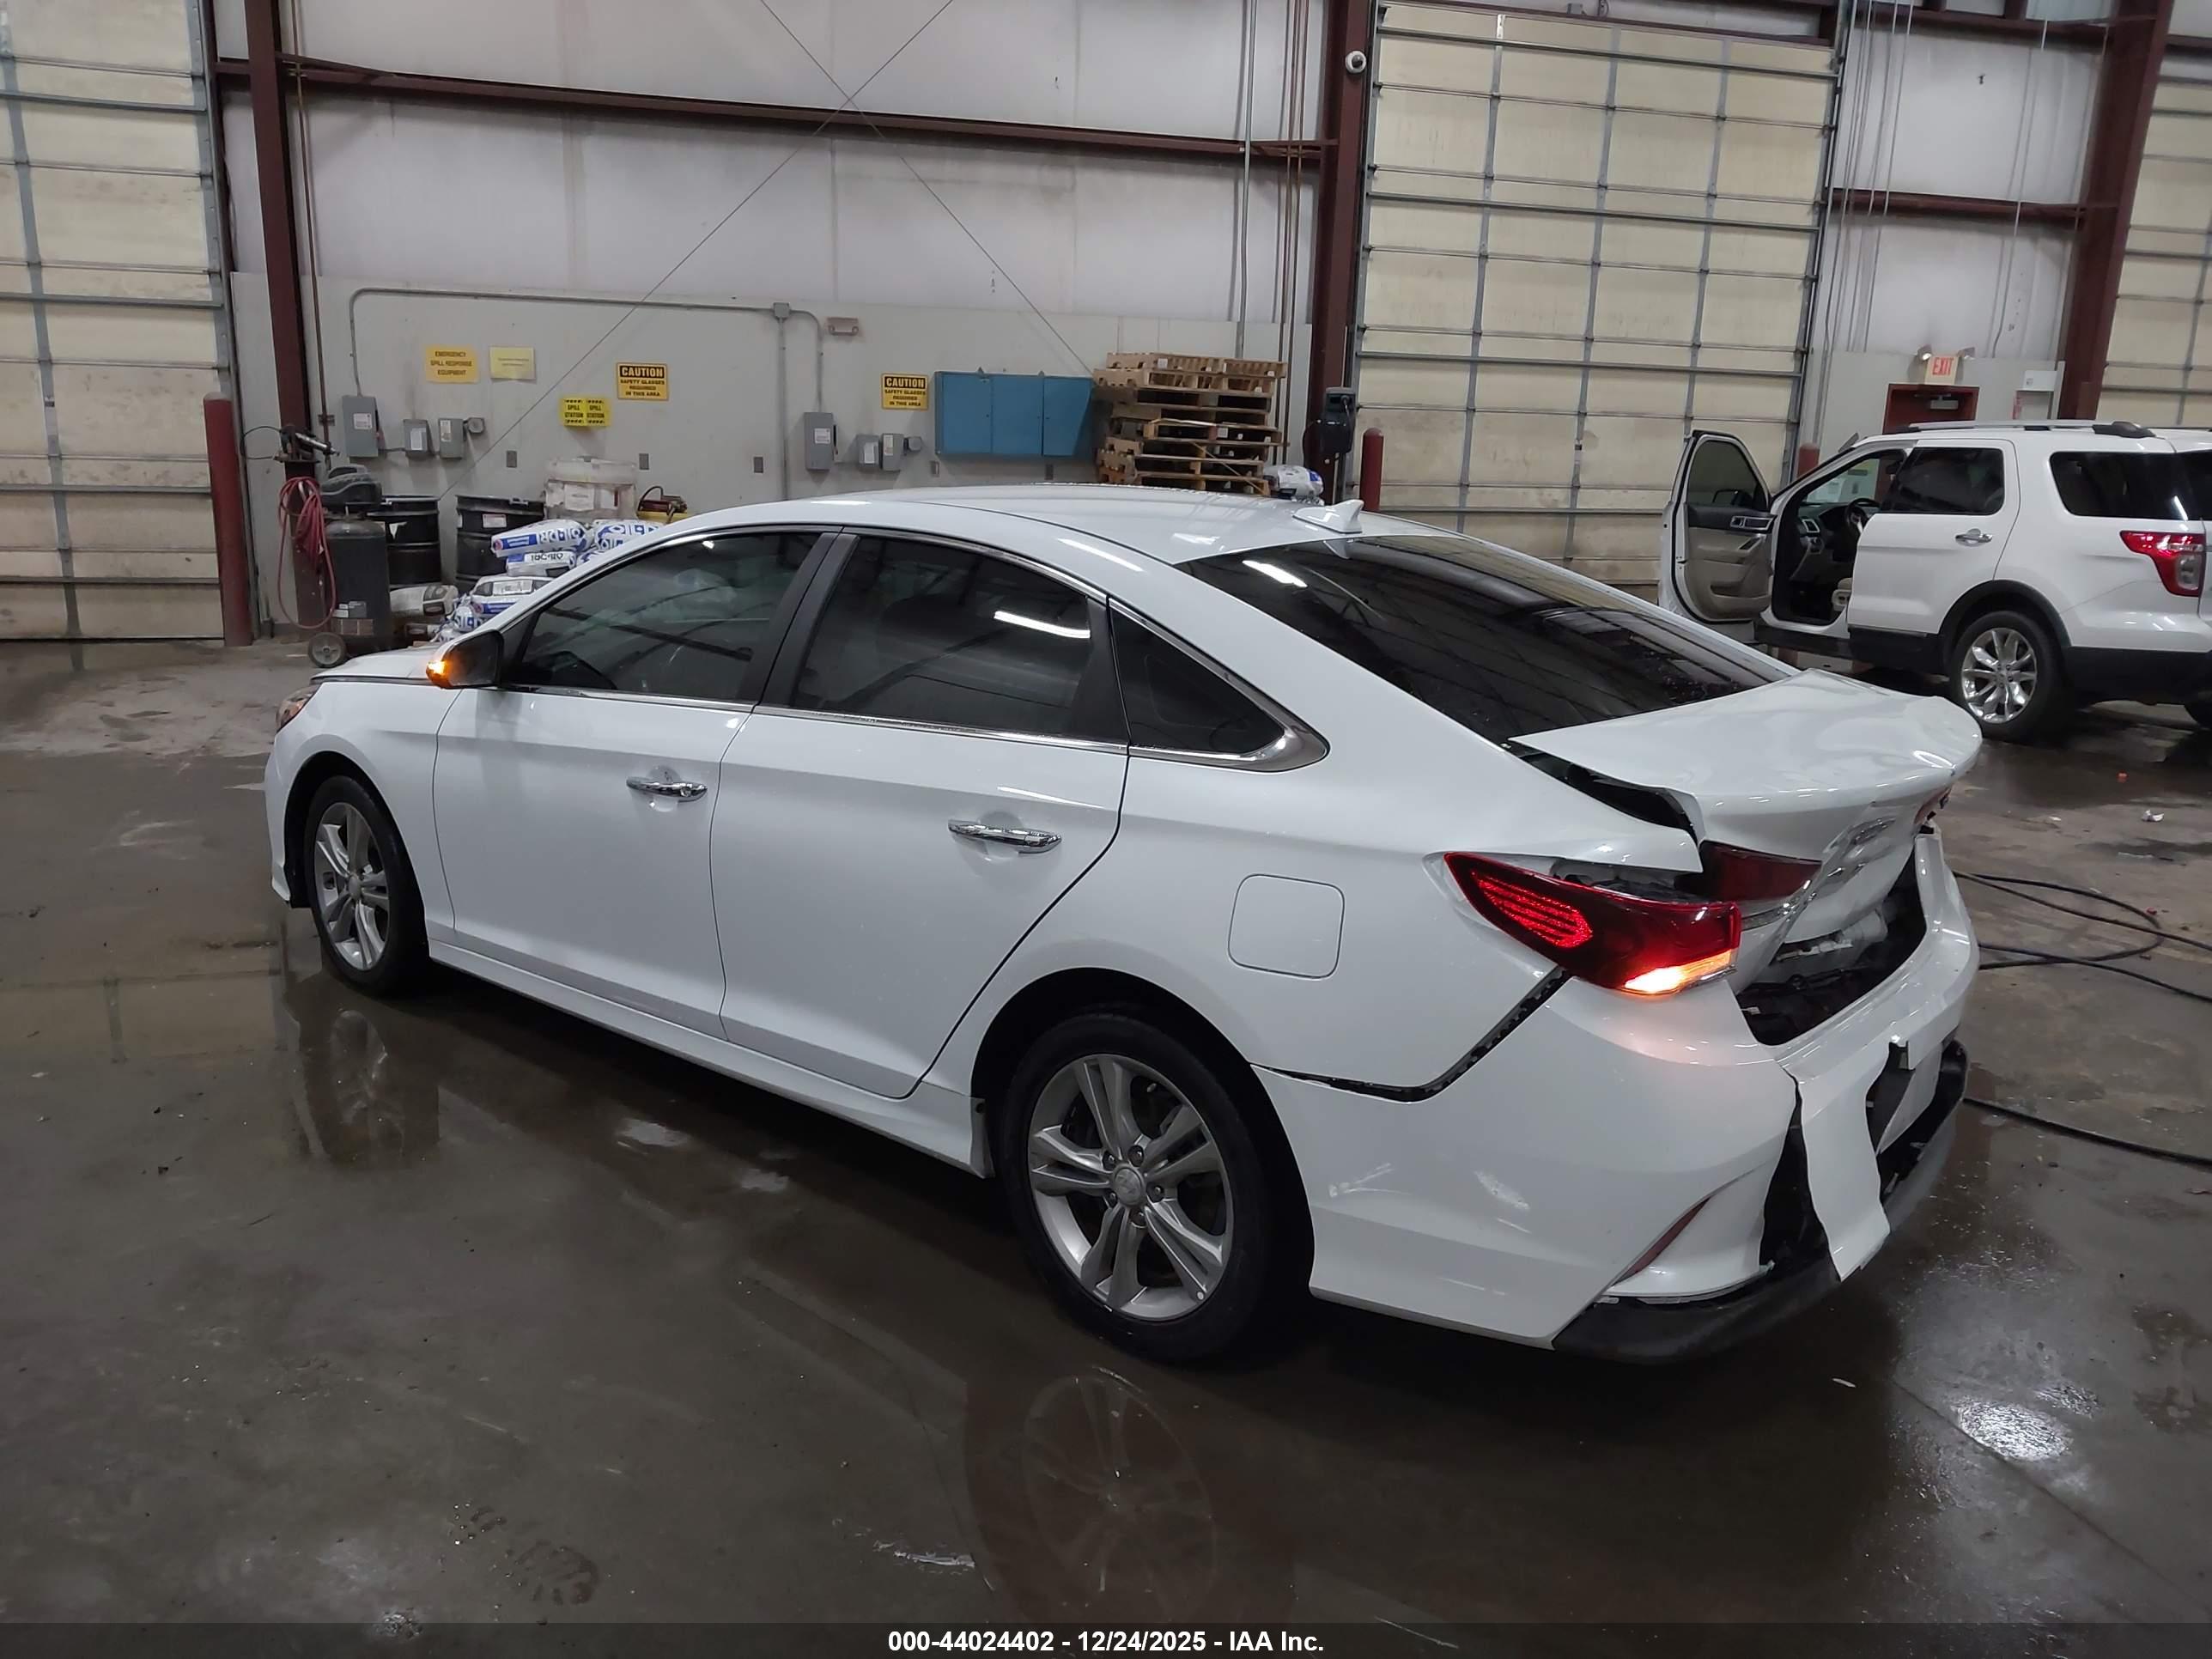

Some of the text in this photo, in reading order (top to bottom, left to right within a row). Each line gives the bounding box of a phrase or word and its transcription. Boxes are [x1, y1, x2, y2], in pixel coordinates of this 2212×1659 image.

[1932, 356, 1954, 375] EXIT
[621, 367, 664, 378] CAUTION
[885, 377, 925, 387] CAUTION
